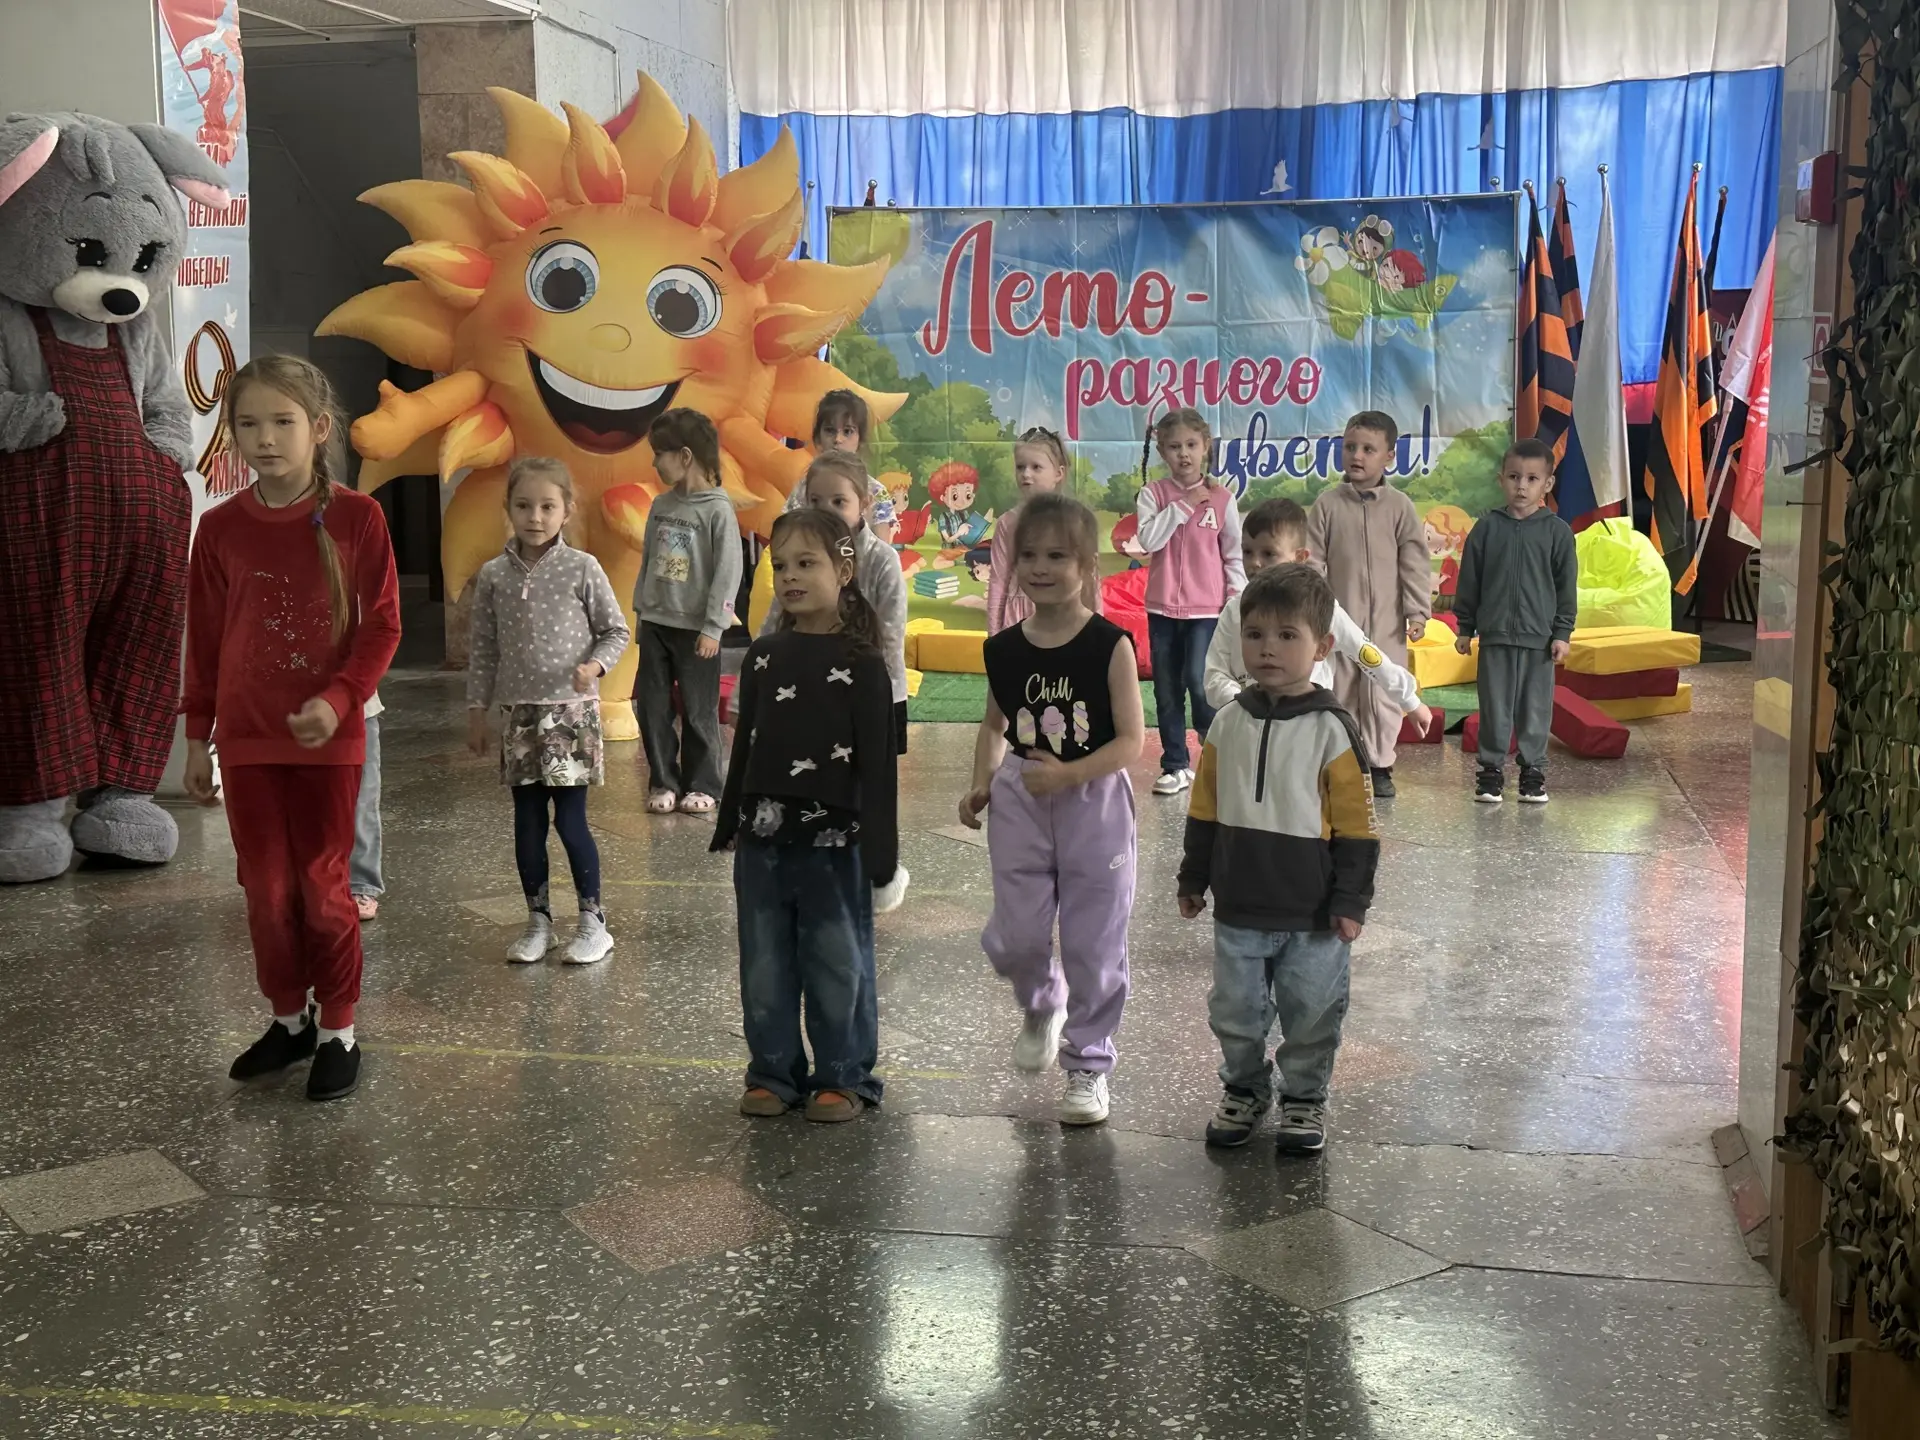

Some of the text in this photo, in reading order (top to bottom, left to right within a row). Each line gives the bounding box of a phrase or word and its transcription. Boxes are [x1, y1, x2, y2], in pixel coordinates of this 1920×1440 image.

[188, 194, 247, 227] ВЕЛИКОЙ
[177, 256, 230, 288] ПОБЕДЫ!
[1066, 357, 1322, 440] разного
[1025, 673, 1073, 704] Chill
